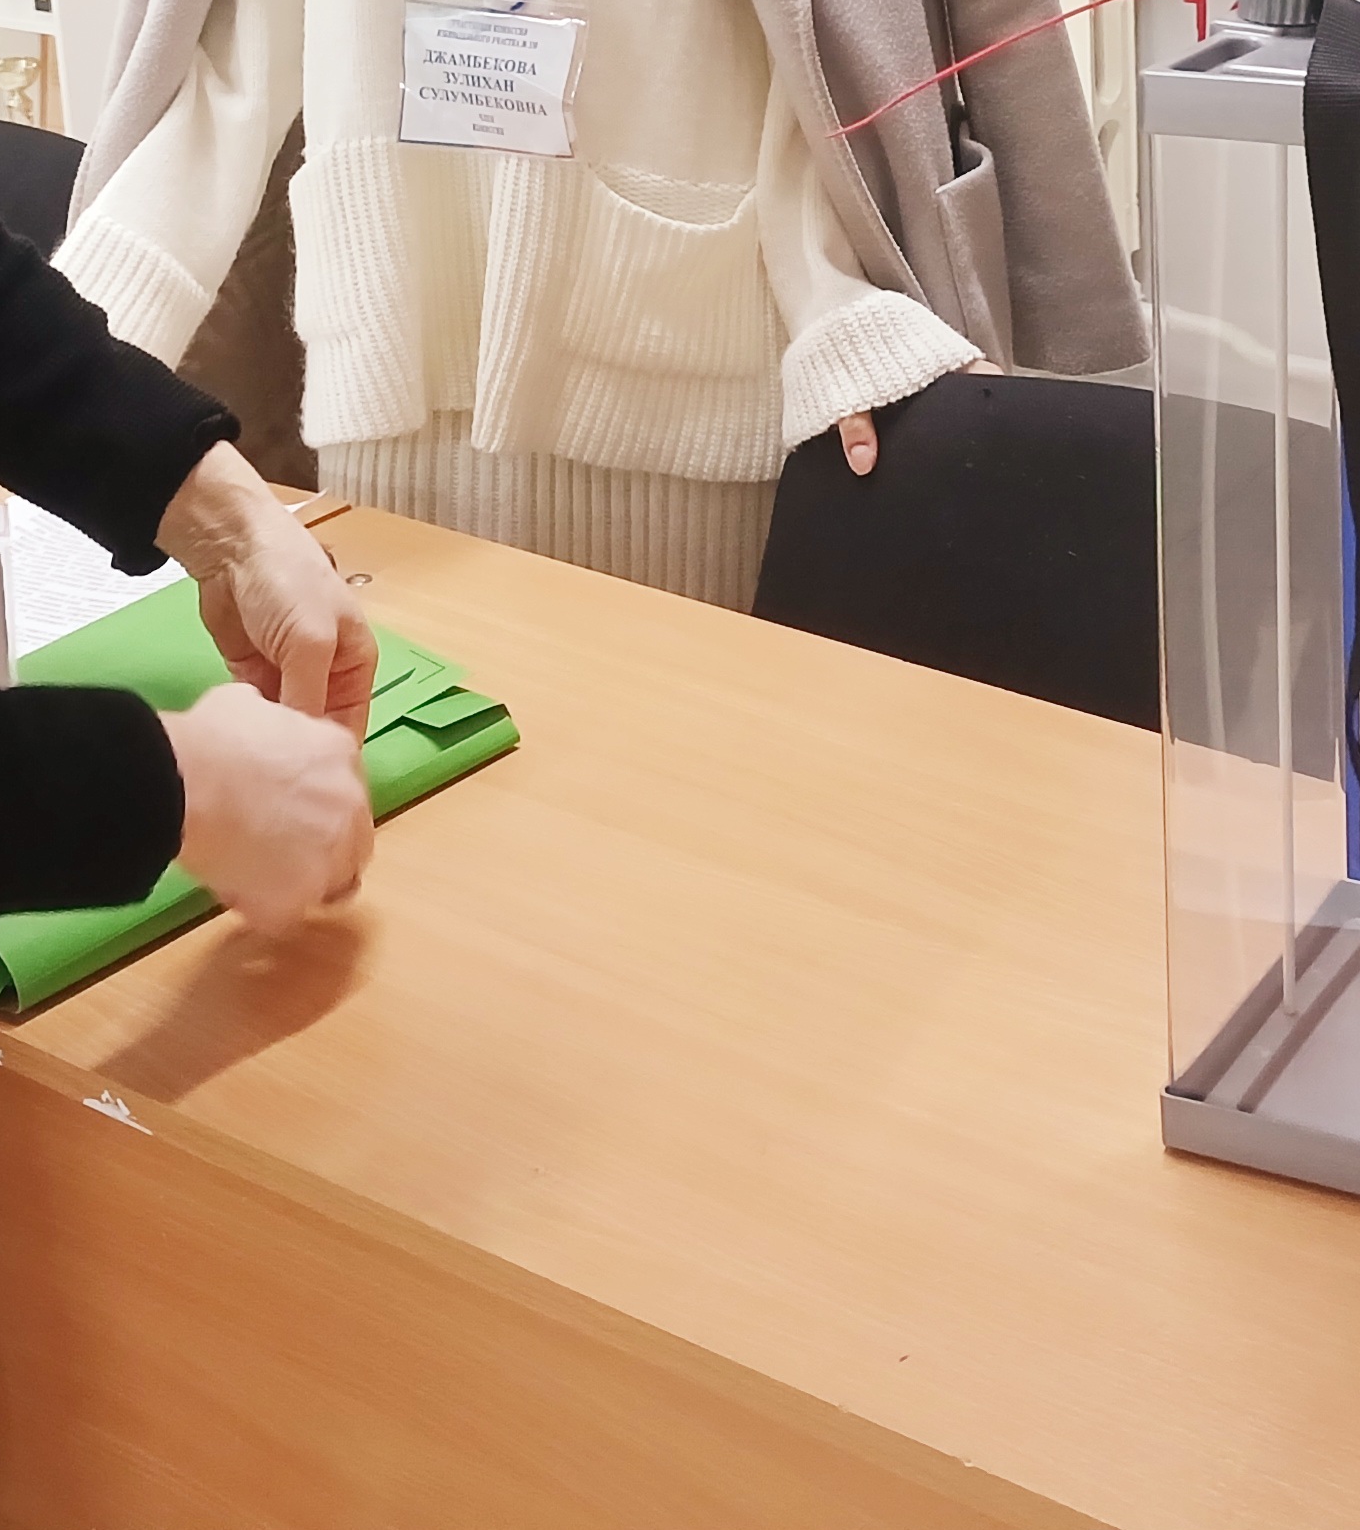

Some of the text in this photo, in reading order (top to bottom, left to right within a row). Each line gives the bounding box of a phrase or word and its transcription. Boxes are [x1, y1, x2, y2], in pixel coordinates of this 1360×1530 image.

[423, 49, 537, 76] ДЖАМБЕКОВА
[443, 71, 514, 93] ЗУЛИХАН
[419, 86, 548, 116] СУЛУМБЕКОВНА
